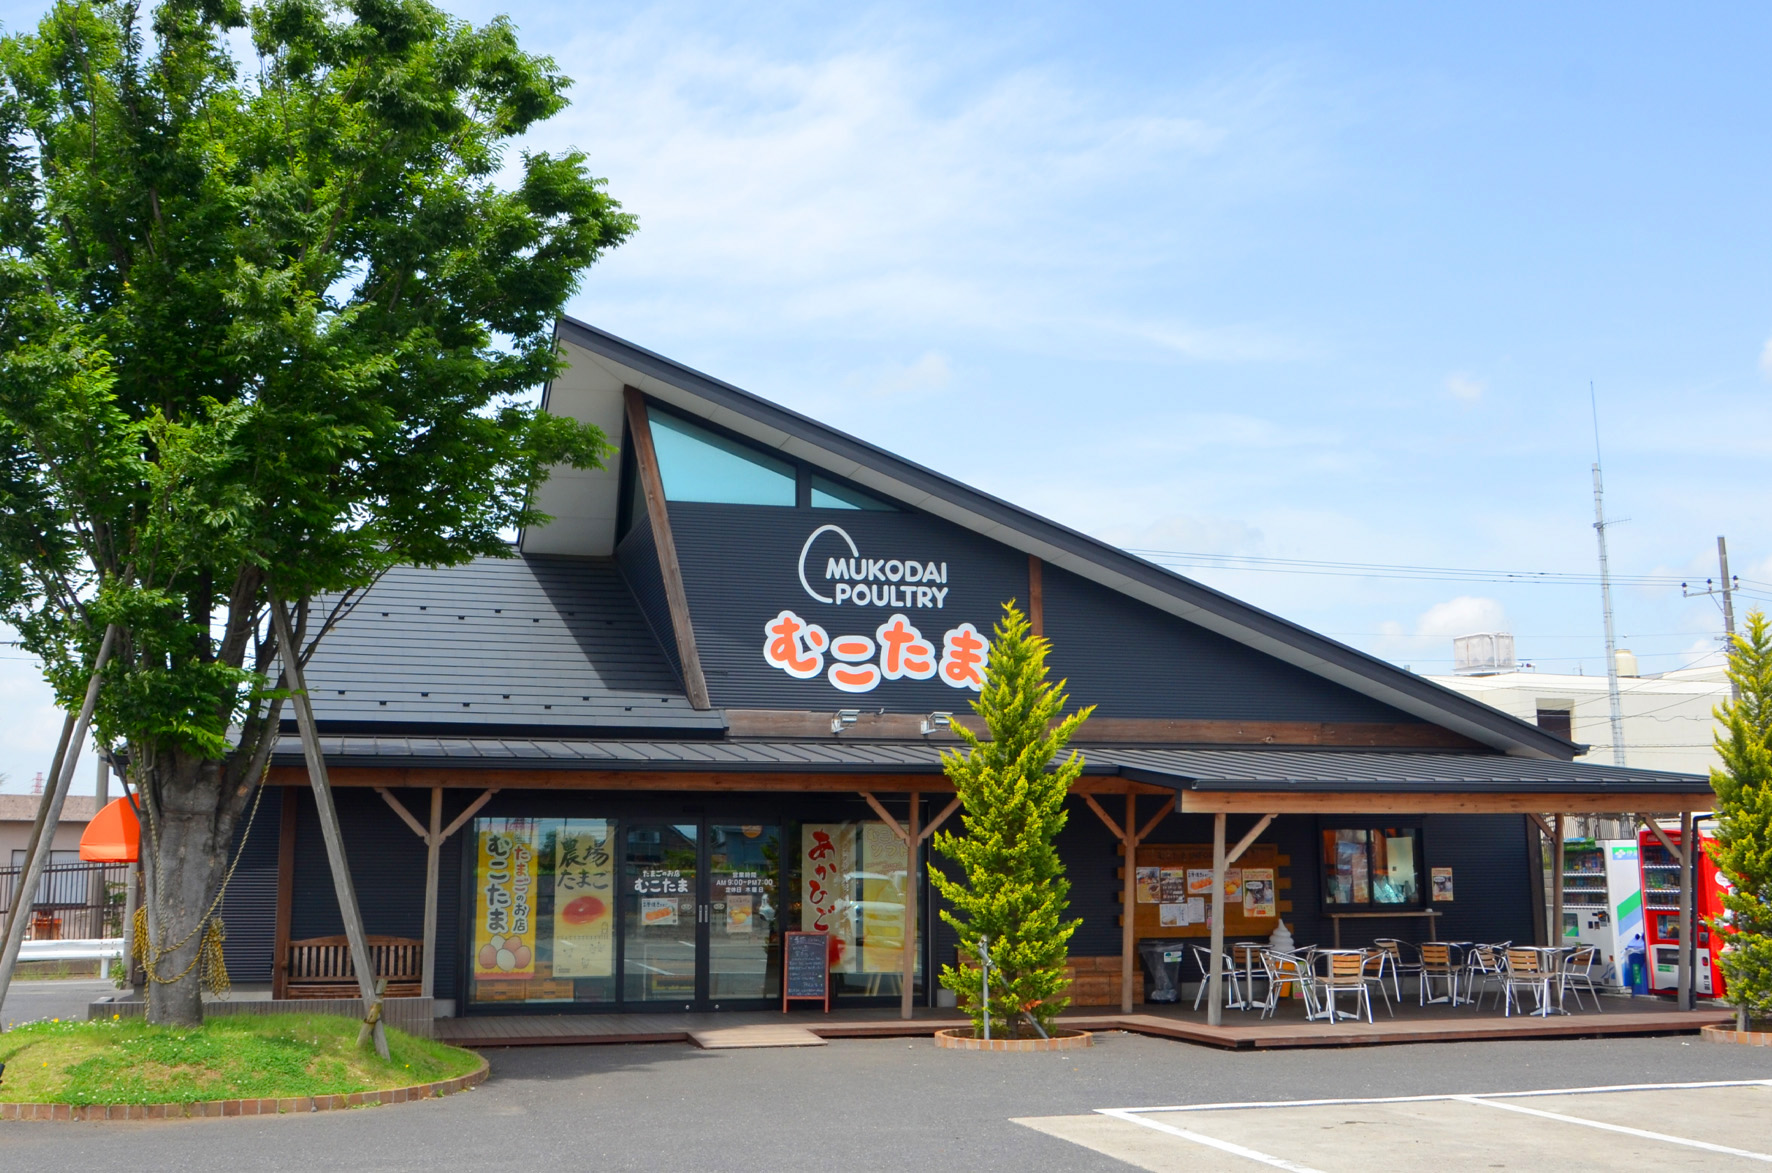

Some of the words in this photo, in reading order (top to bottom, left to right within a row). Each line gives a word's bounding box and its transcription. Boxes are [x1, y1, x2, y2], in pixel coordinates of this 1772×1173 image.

[826, 557, 947, 584] MUKODAI
[836, 583, 949, 608] POULTRY
[764, 611, 989, 692] むこたま
[559, 837, 610, 868] 農場
[487, 835, 512, 933] むこたま
[557, 868, 610, 891] たまご
[634, 877, 689, 893] むこたま
[642, 869, 681, 878] たまごのお店
[808, 828, 837, 932] あかひご
[512, 845, 531, 934] たまごのお店
